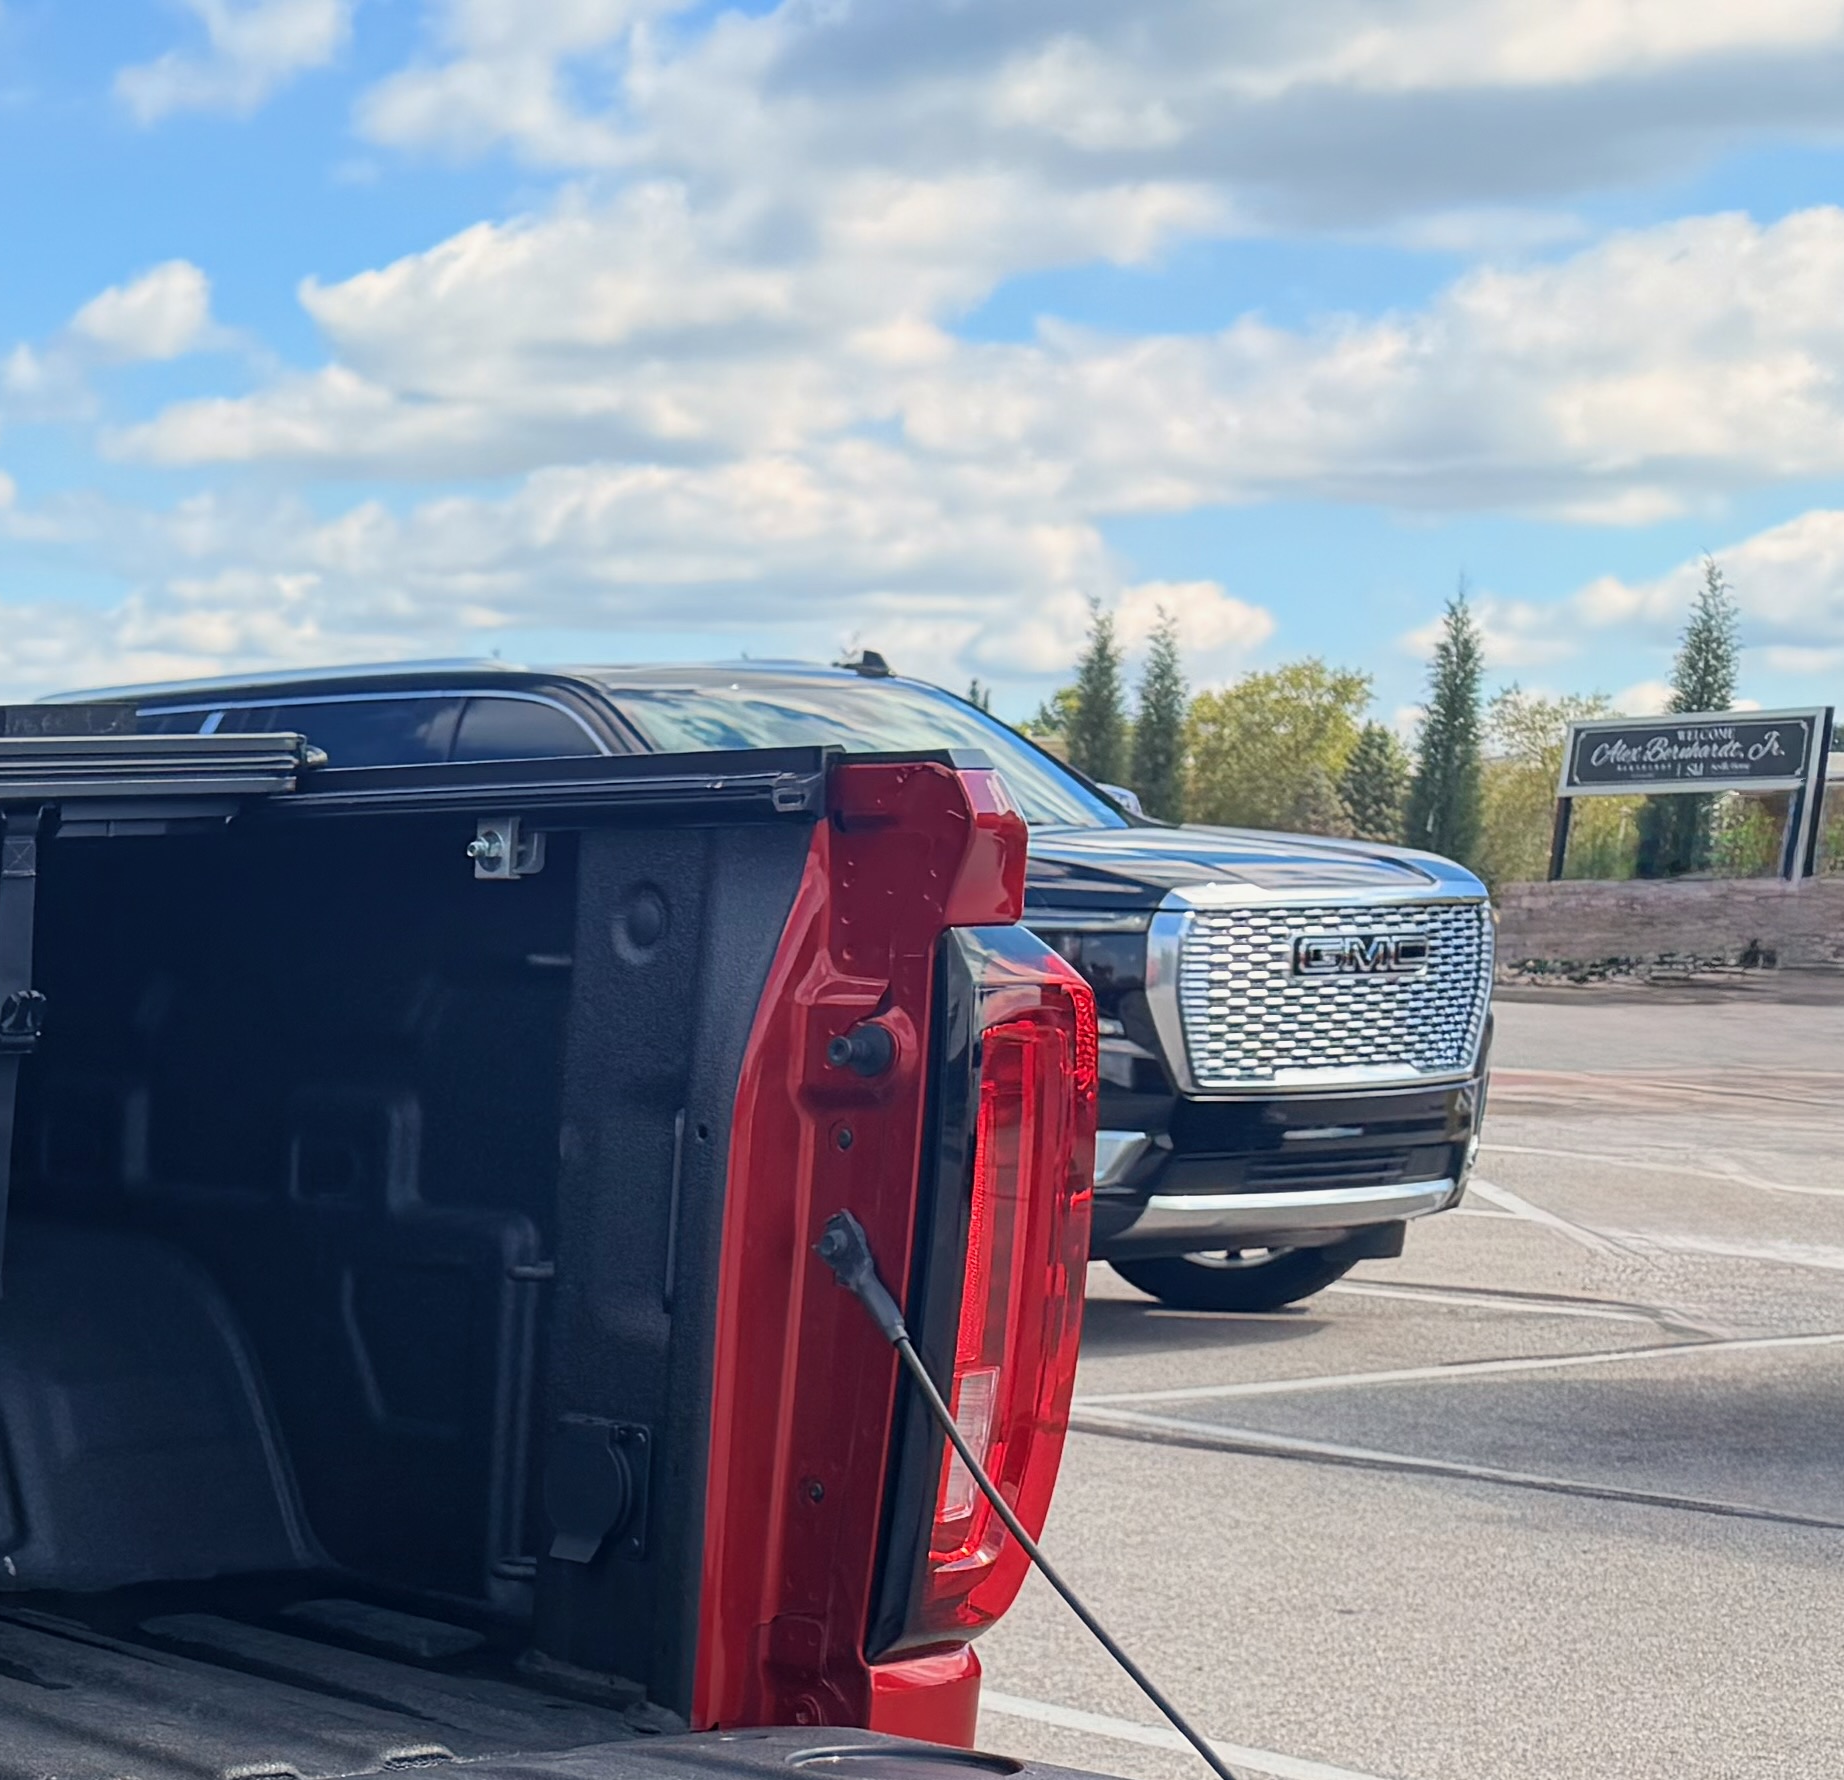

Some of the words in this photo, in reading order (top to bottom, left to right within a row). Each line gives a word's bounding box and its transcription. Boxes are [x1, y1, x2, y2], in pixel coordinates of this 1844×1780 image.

[1677, 728, 1736, 742] WELCOME
[1590, 738, 1643, 767] Alex
[1297, 935, 1429, 973] GMC
